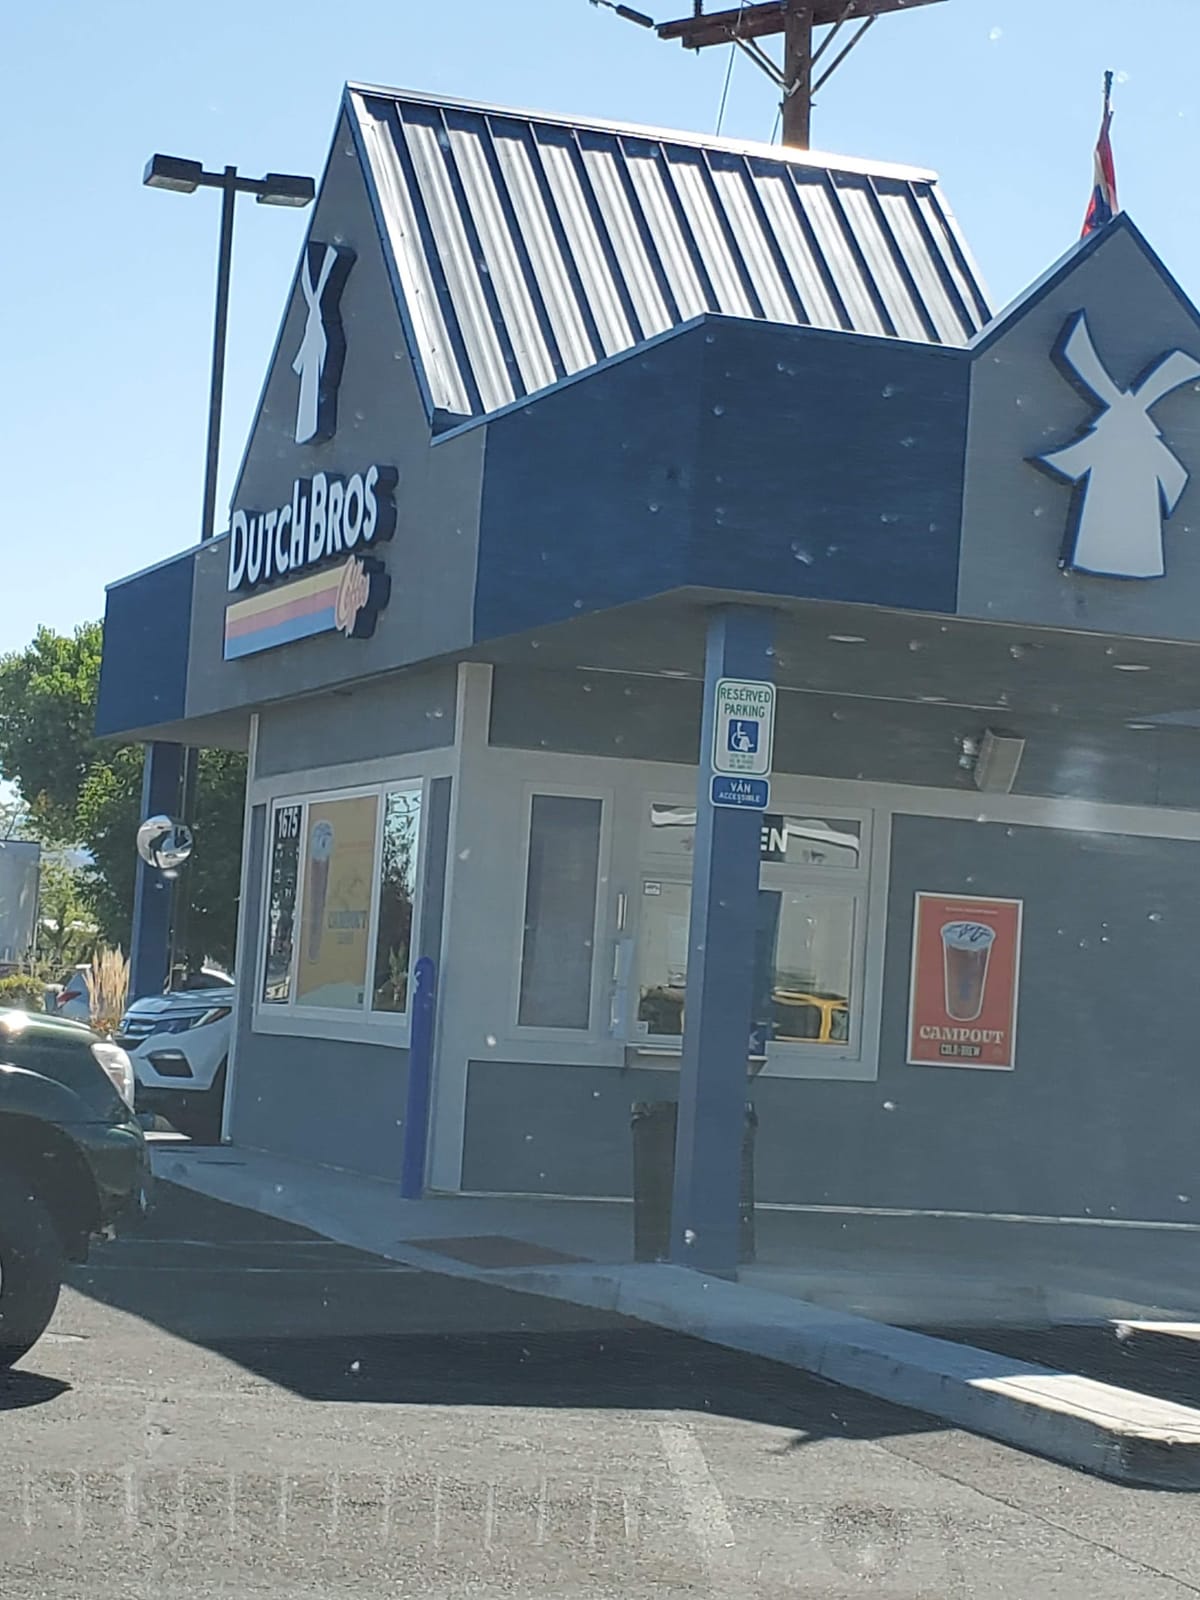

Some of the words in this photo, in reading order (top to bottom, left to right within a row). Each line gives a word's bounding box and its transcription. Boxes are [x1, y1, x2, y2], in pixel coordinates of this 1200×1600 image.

[228, 479, 306, 592] DUTCH
[308, 465, 379, 563] BROS
[719, 687, 771, 703] RESERVED
[724, 703, 766, 718] PARKING
[730, 781, 751, 793] VAN
[718, 791, 761, 803] ACCESSIBLE
[278, 807, 299, 838] 1675
[760, 826, 788, 852] EN
[919, 1025, 1004, 1044] CAMPOUT
